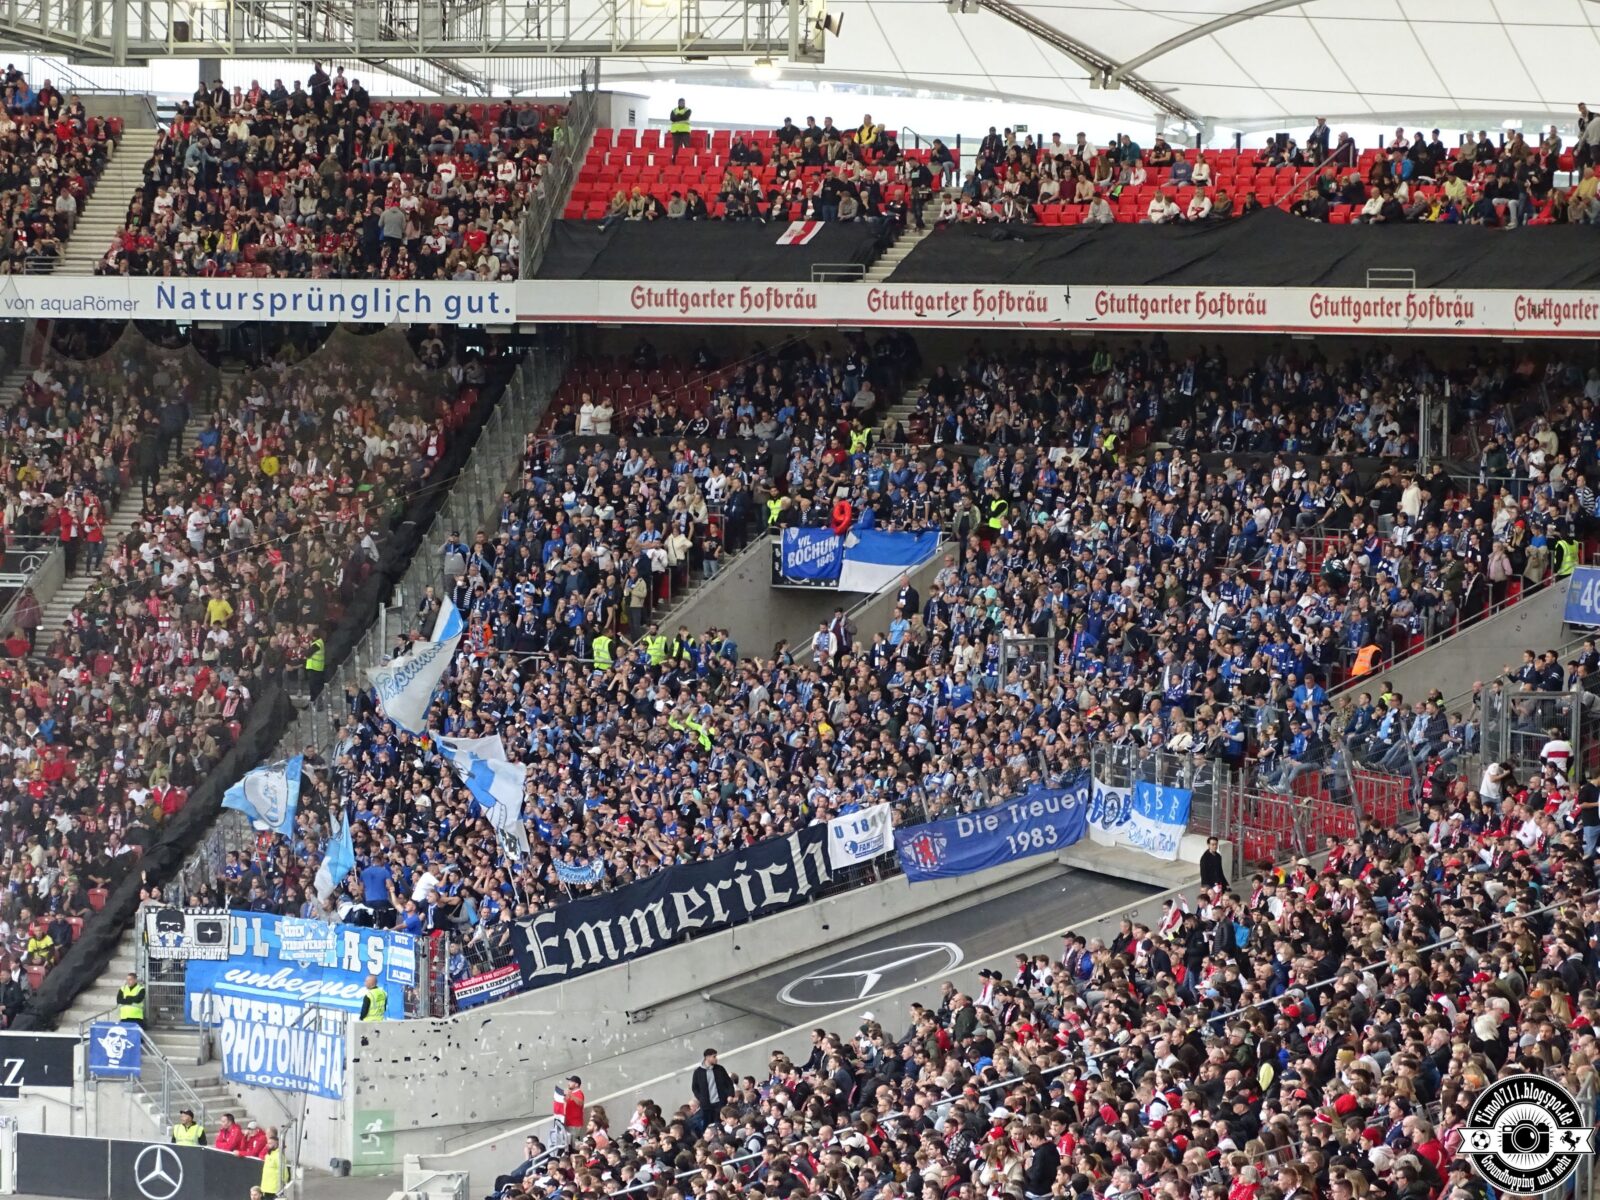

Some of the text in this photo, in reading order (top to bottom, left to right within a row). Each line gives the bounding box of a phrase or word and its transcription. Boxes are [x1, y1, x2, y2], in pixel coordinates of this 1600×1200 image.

[5, 296, 140, 314] von aquaRömer
[157, 285, 511, 321] Natursprünglich gut.
[631, 285, 817, 314] Stuttgarter Hofbräu
[867, 288, 1048, 317] Stuttgarter Hofbräu
[1095, 290, 1267, 320] Stuttgarter Hofbräu
[1310, 293, 1474, 323] Stuttgarter Hofbräu
[1515, 294, 1599, 327] Stuttgarter
[788, 535, 840, 569] BOCHUM
[957, 815, 999, 839] Die
[1008, 788, 1090, 823] Treuen
[1006, 825, 1058, 855] 1983
[517, 830, 832, 979] Emmerich
[229, 916, 385, 976] ULAS
[221, 1018, 343, 1097] PHOTOMAFIA
[245, 1073, 321, 1092] BOCHUM
